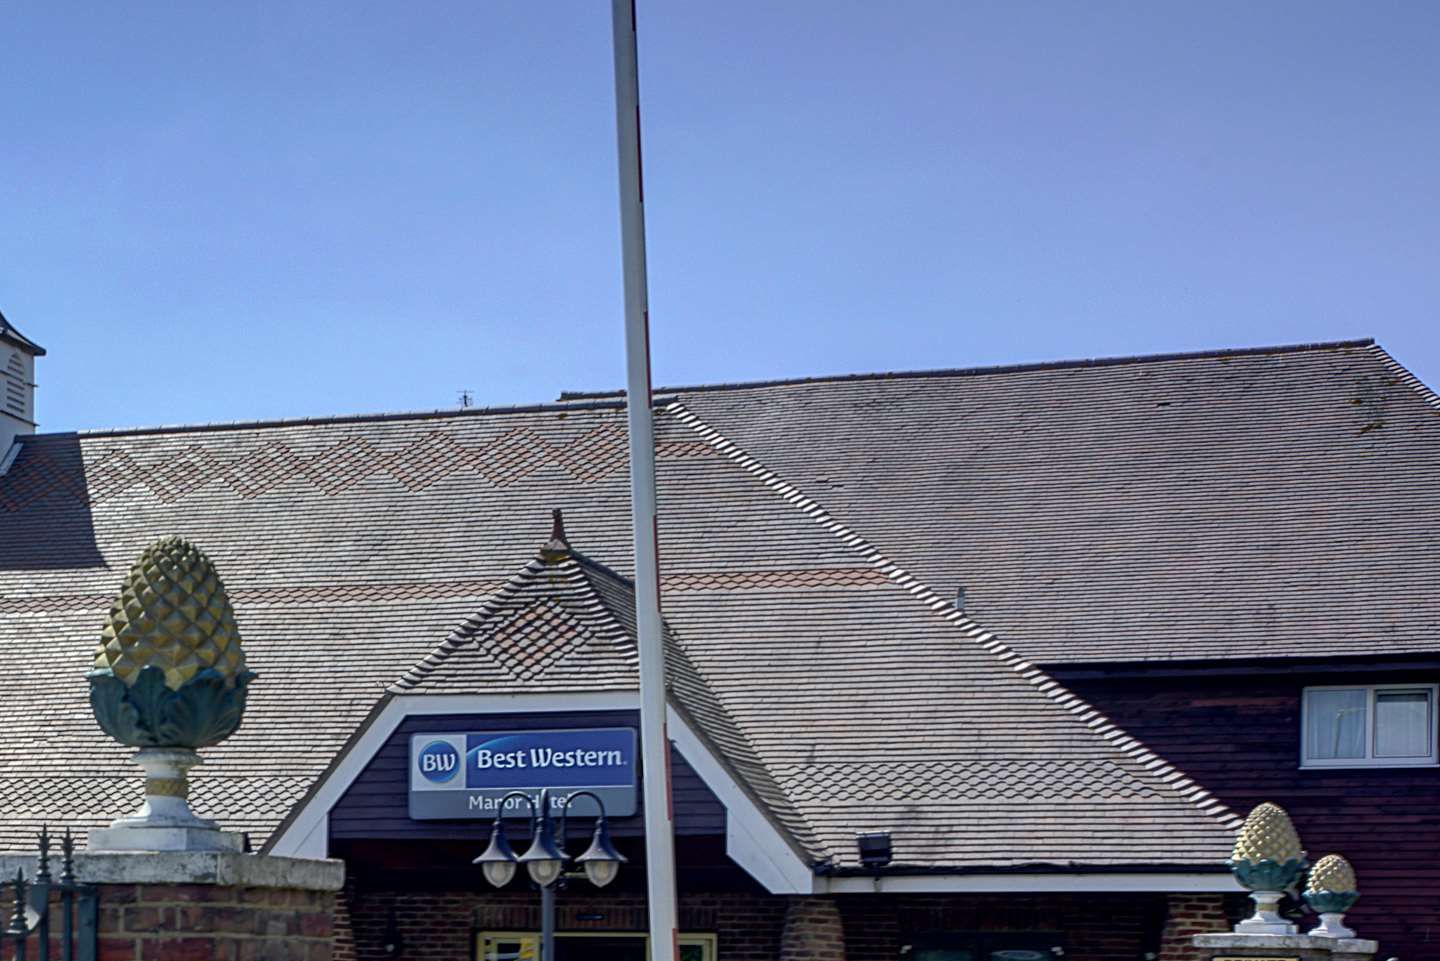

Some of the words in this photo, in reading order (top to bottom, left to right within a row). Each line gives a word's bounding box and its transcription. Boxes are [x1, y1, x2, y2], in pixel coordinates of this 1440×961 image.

[423, 753, 455, 772] BW
[477, 749, 526, 769] Best
[530, 748, 622, 767] Western
[526, 794, 572, 809] Htel
